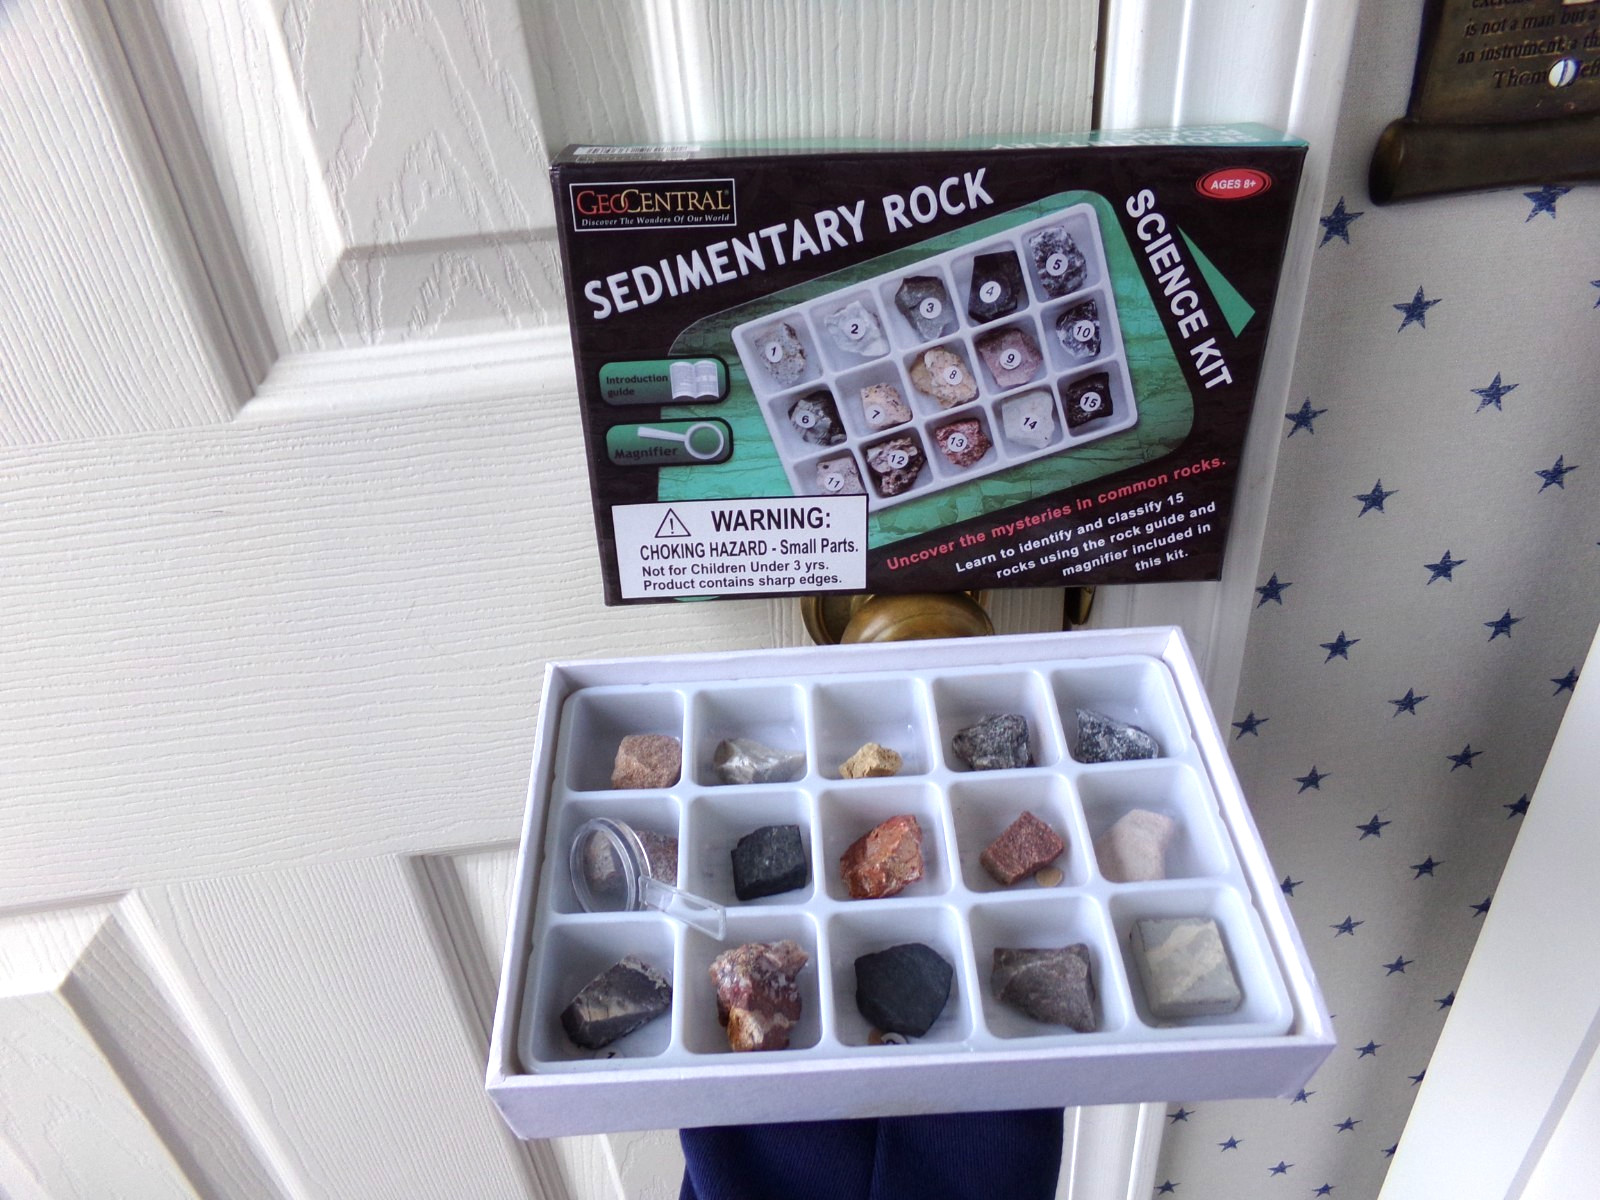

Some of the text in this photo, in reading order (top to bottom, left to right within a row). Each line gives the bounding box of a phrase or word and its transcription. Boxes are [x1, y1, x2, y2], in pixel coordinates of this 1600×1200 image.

[1465, 18, 1476, 36] is
[1481, 18, 1506, 34] not
[1510, 21, 1518, 30] a
[1522, 14, 1555, 29] man
[1561, 9, 1585, 24] but
[1457, 50, 1475, 64] an
[1210, 178, 1257, 190] AGES 8+
[581, 214, 730, 227] Discover The Wonders Of Our World
[584, 168, 994, 320] SEDIMENTARY ROCK
[1052, 258, 1062, 270] 5
[985, 285, 995, 297] 4
[1126, 188, 1233, 390] SCIENCE KIT
[926, 302, 935, 314] 3
[851, 324, 859, 334] 2
[1076, 325, 1091, 337] 10
[771, 347, 777, 356] 1
[1006, 353, 1015, 364] 9
[606, 373, 669, 384] Introduction
[949, 369, 957, 380] 8
[607, 388, 635, 398] guide
[1082, 396, 1098, 409] 15
[802, 415, 809, 424] 6
[872, 410, 880, 420] 7
[1022, 416, 1038, 430] 14
[950, 436, 964, 448] 13
[614, 446, 679, 460] Magnifier
[890, 454, 905, 465] 12
[827, 477, 841, 489] 11
[711, 506, 831, 532] WARNING:
[886, 456, 1226, 572] Uncover the mysteries in common rocks.
[955, 492, 1184, 573] Learn to identify and classify 15
[996, 501, 1216, 579] rocks using the rock guide and
[640, 542, 705, 561] CHOKING
[709, 540, 767, 557] HAZARD
[780, 538, 816, 555] Small
[821, 537, 858, 553] Parts.
[1062, 522, 1211, 576] magnifier included in
[1134, 549, 1189, 572] this kit.
[642, 560, 829, 577] Not for Children Under 3 yrs.
[644, 573, 842, 590] Product contains sharp edges.
